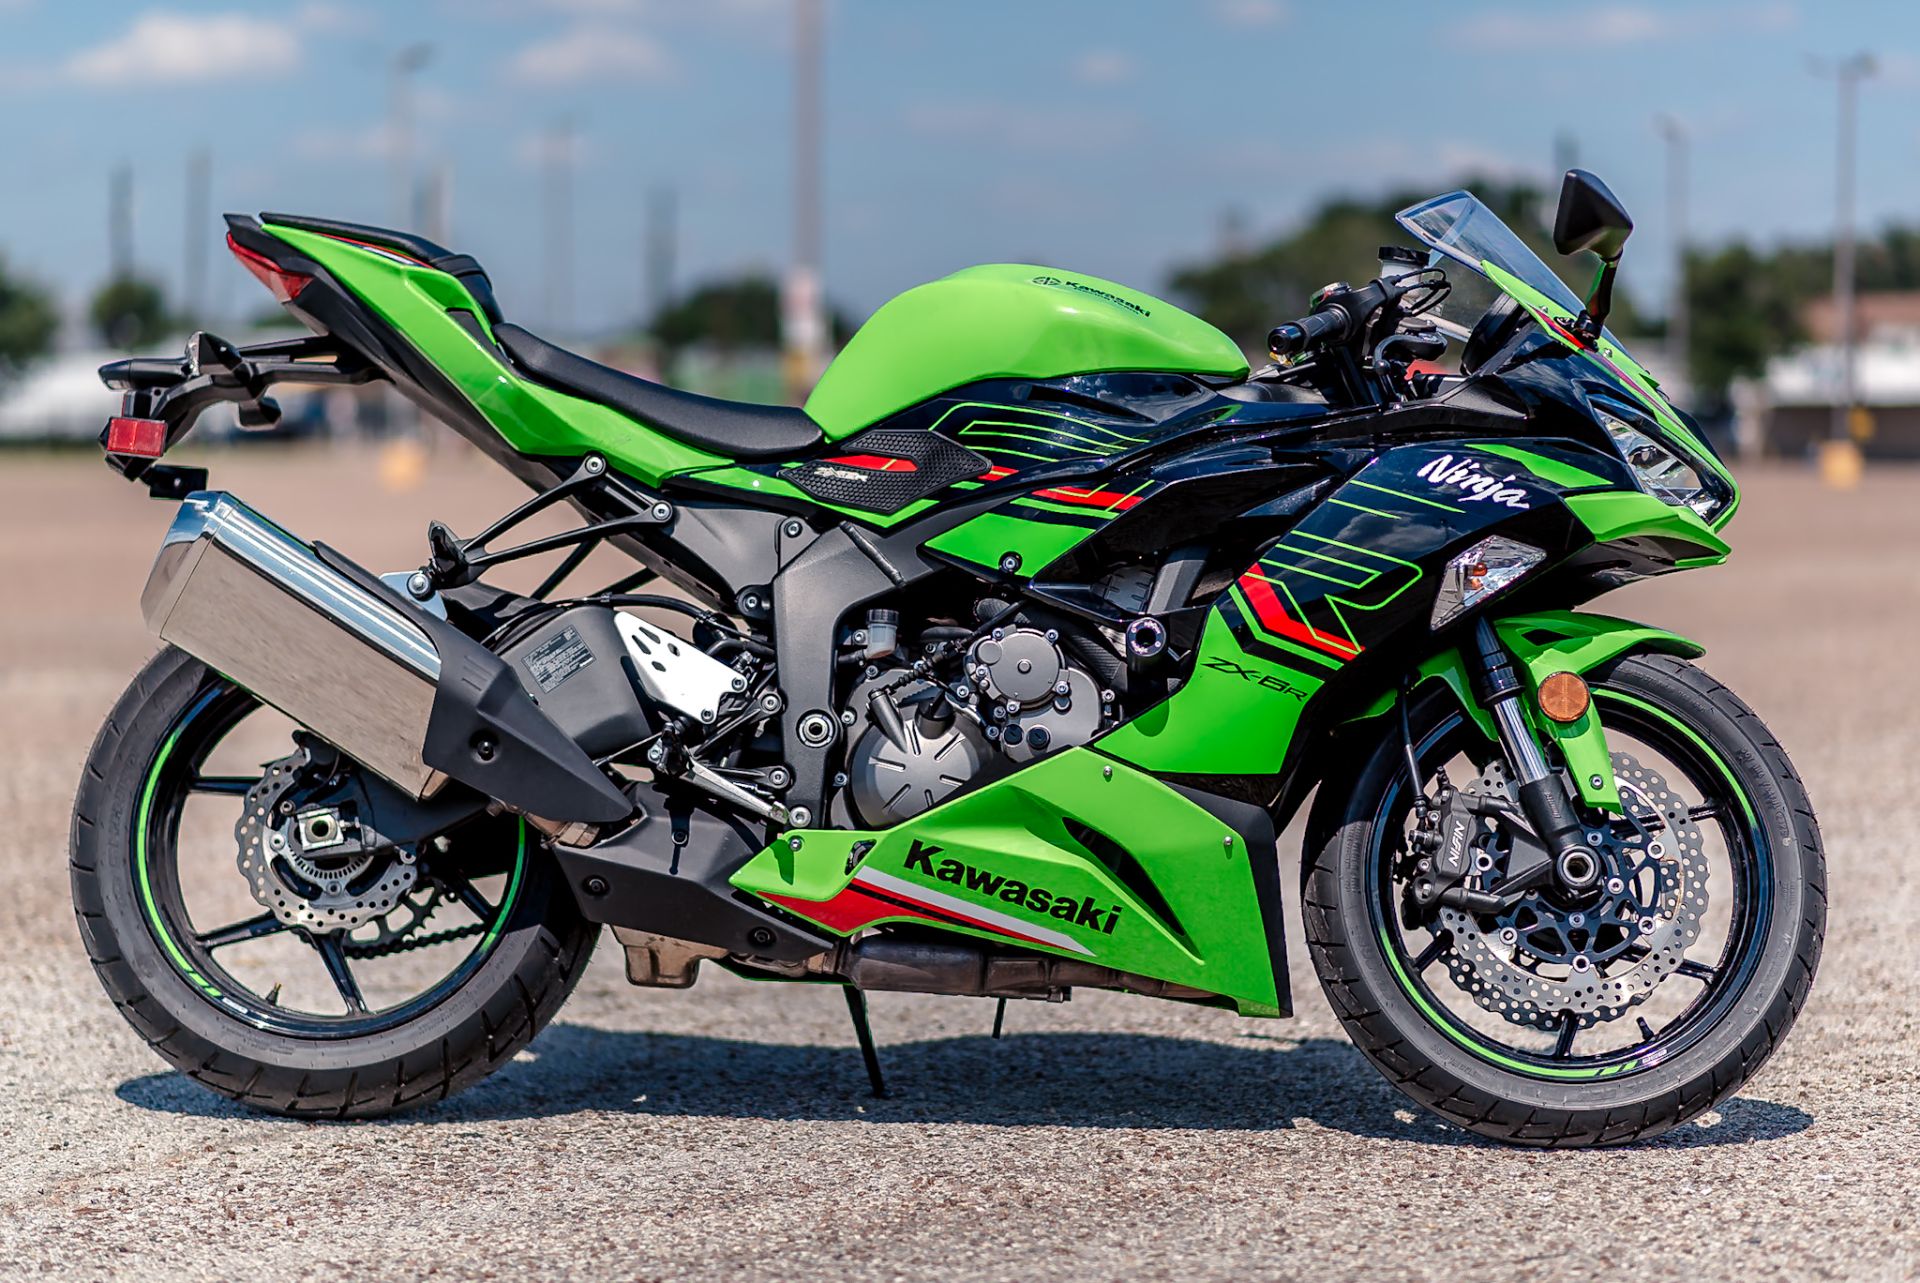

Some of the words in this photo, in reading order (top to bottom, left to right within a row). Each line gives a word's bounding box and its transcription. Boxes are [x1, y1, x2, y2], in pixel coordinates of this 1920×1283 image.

[1065, 281, 1151, 317] Kawasaki
[1416, 454, 1530, 509] Ninja
[1200, 656, 1308, 703] ZX-6R
[1448, 820, 1466, 868] NISSIN
[903, 838, 1124, 936] Kawasaki
